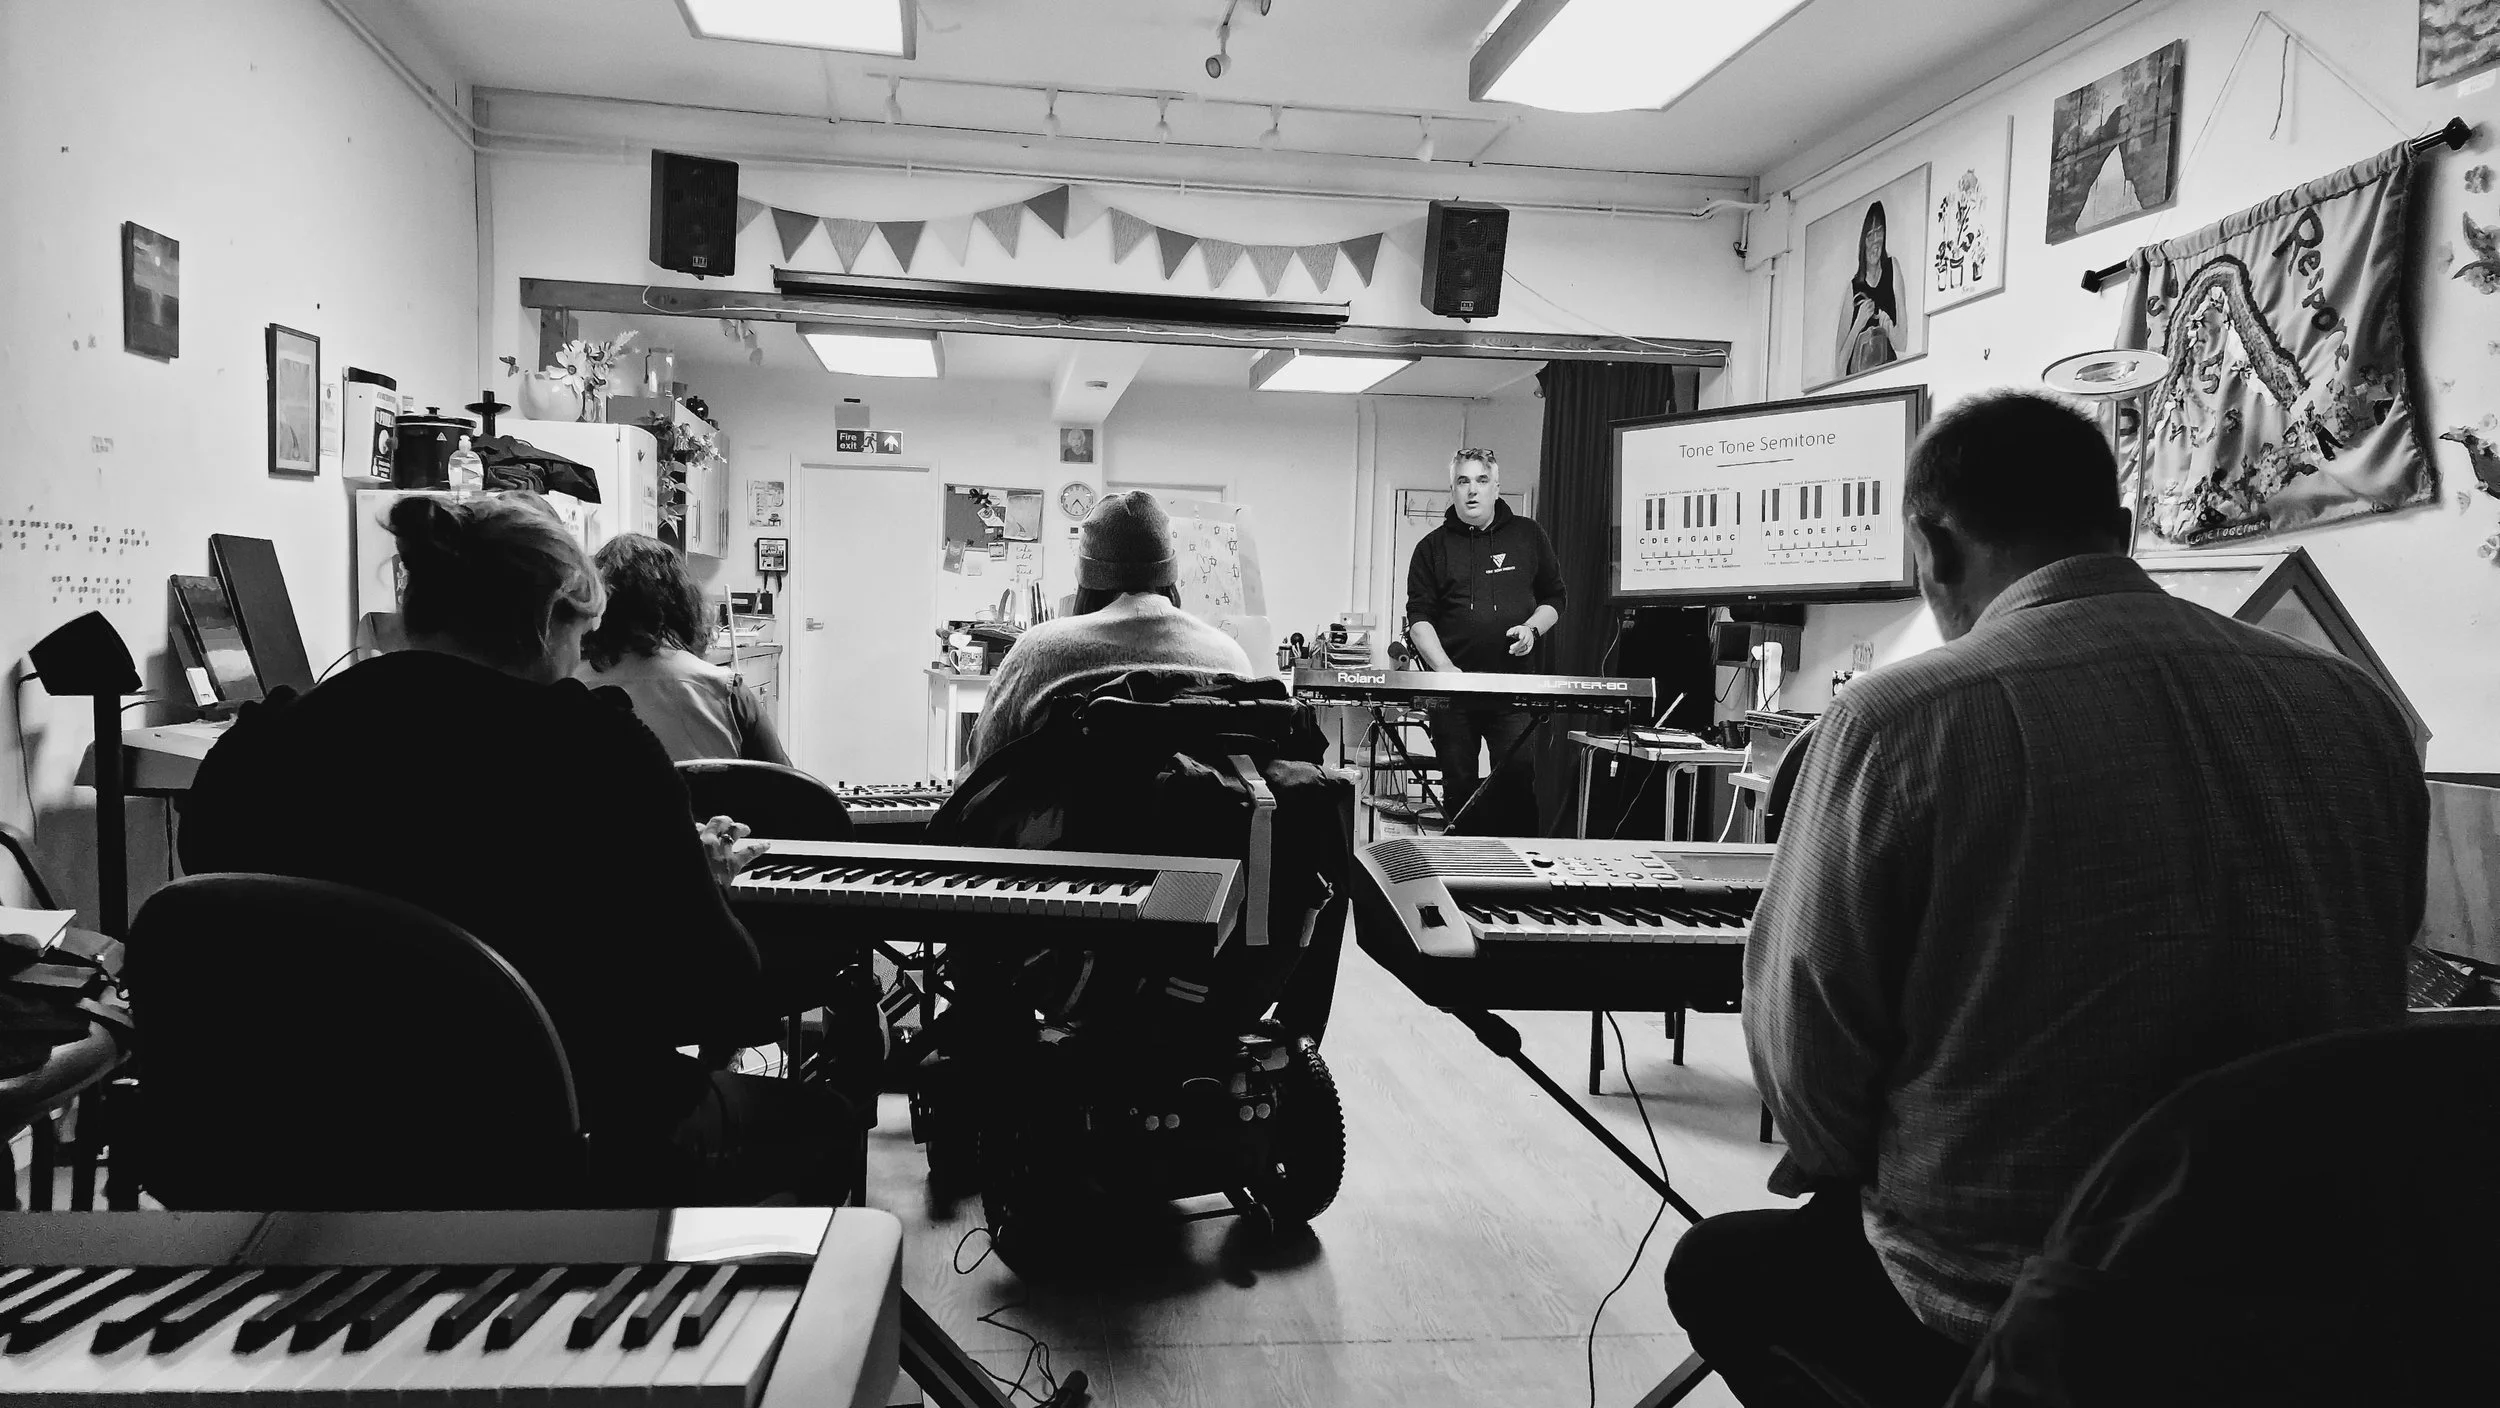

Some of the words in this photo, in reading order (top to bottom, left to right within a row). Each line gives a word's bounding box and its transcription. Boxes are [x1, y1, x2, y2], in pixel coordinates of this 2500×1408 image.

[840, 432, 857, 440] Fire
[840, 442, 857, 450] exit
[1679, 444, 1714, 458] Tone
[1719, 440, 1755, 455] Tone
[1759, 433, 1836, 451] Semitone
[1337, 672, 1386, 684] Roland
